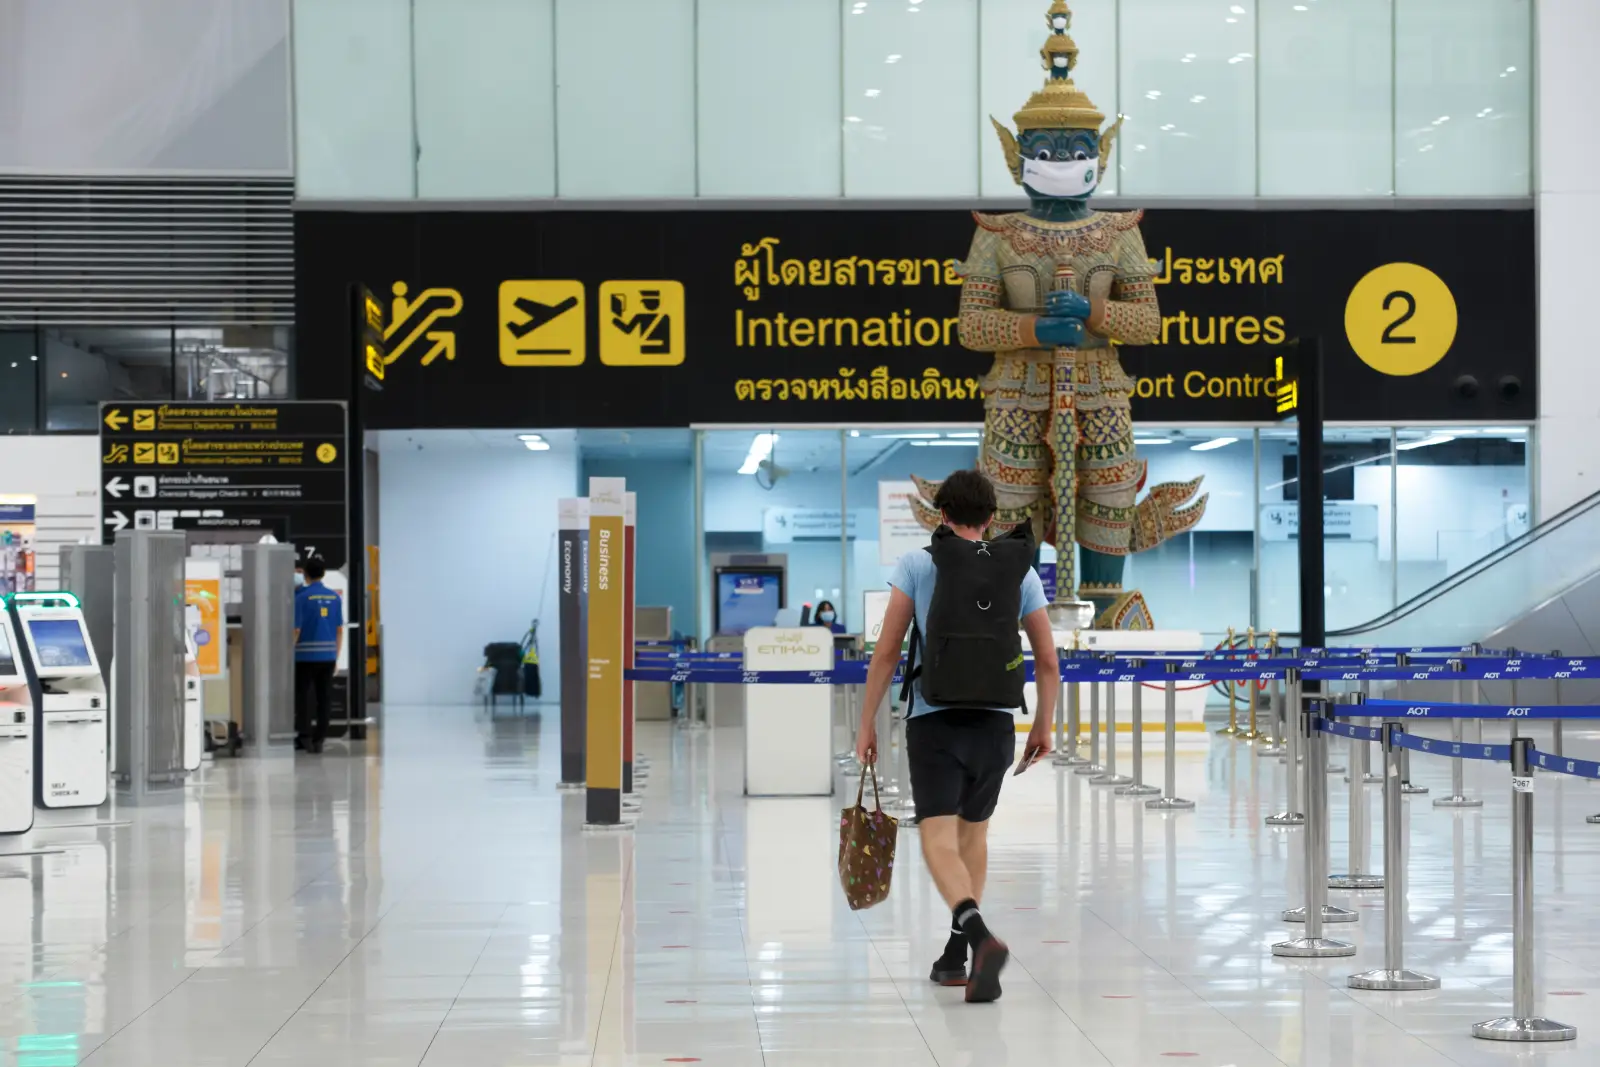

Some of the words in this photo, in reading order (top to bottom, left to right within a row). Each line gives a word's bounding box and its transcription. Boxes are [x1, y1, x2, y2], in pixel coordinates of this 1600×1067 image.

[735, 309, 959, 347] Internation
[1152, 311, 1286, 345] rtures
[1381, 290, 1416, 344] 2
[735, 365, 979, 400] ตรวจหนังสือเดินท
[1183, 371, 1277, 398] Contro
[563, 540, 572, 594] Economy
[599, 529, 610, 590] Business
[757, 645, 820, 654] ETIHAD
[1407, 707, 1430, 715] AOT
[1507, 708, 1530, 716] AOT
